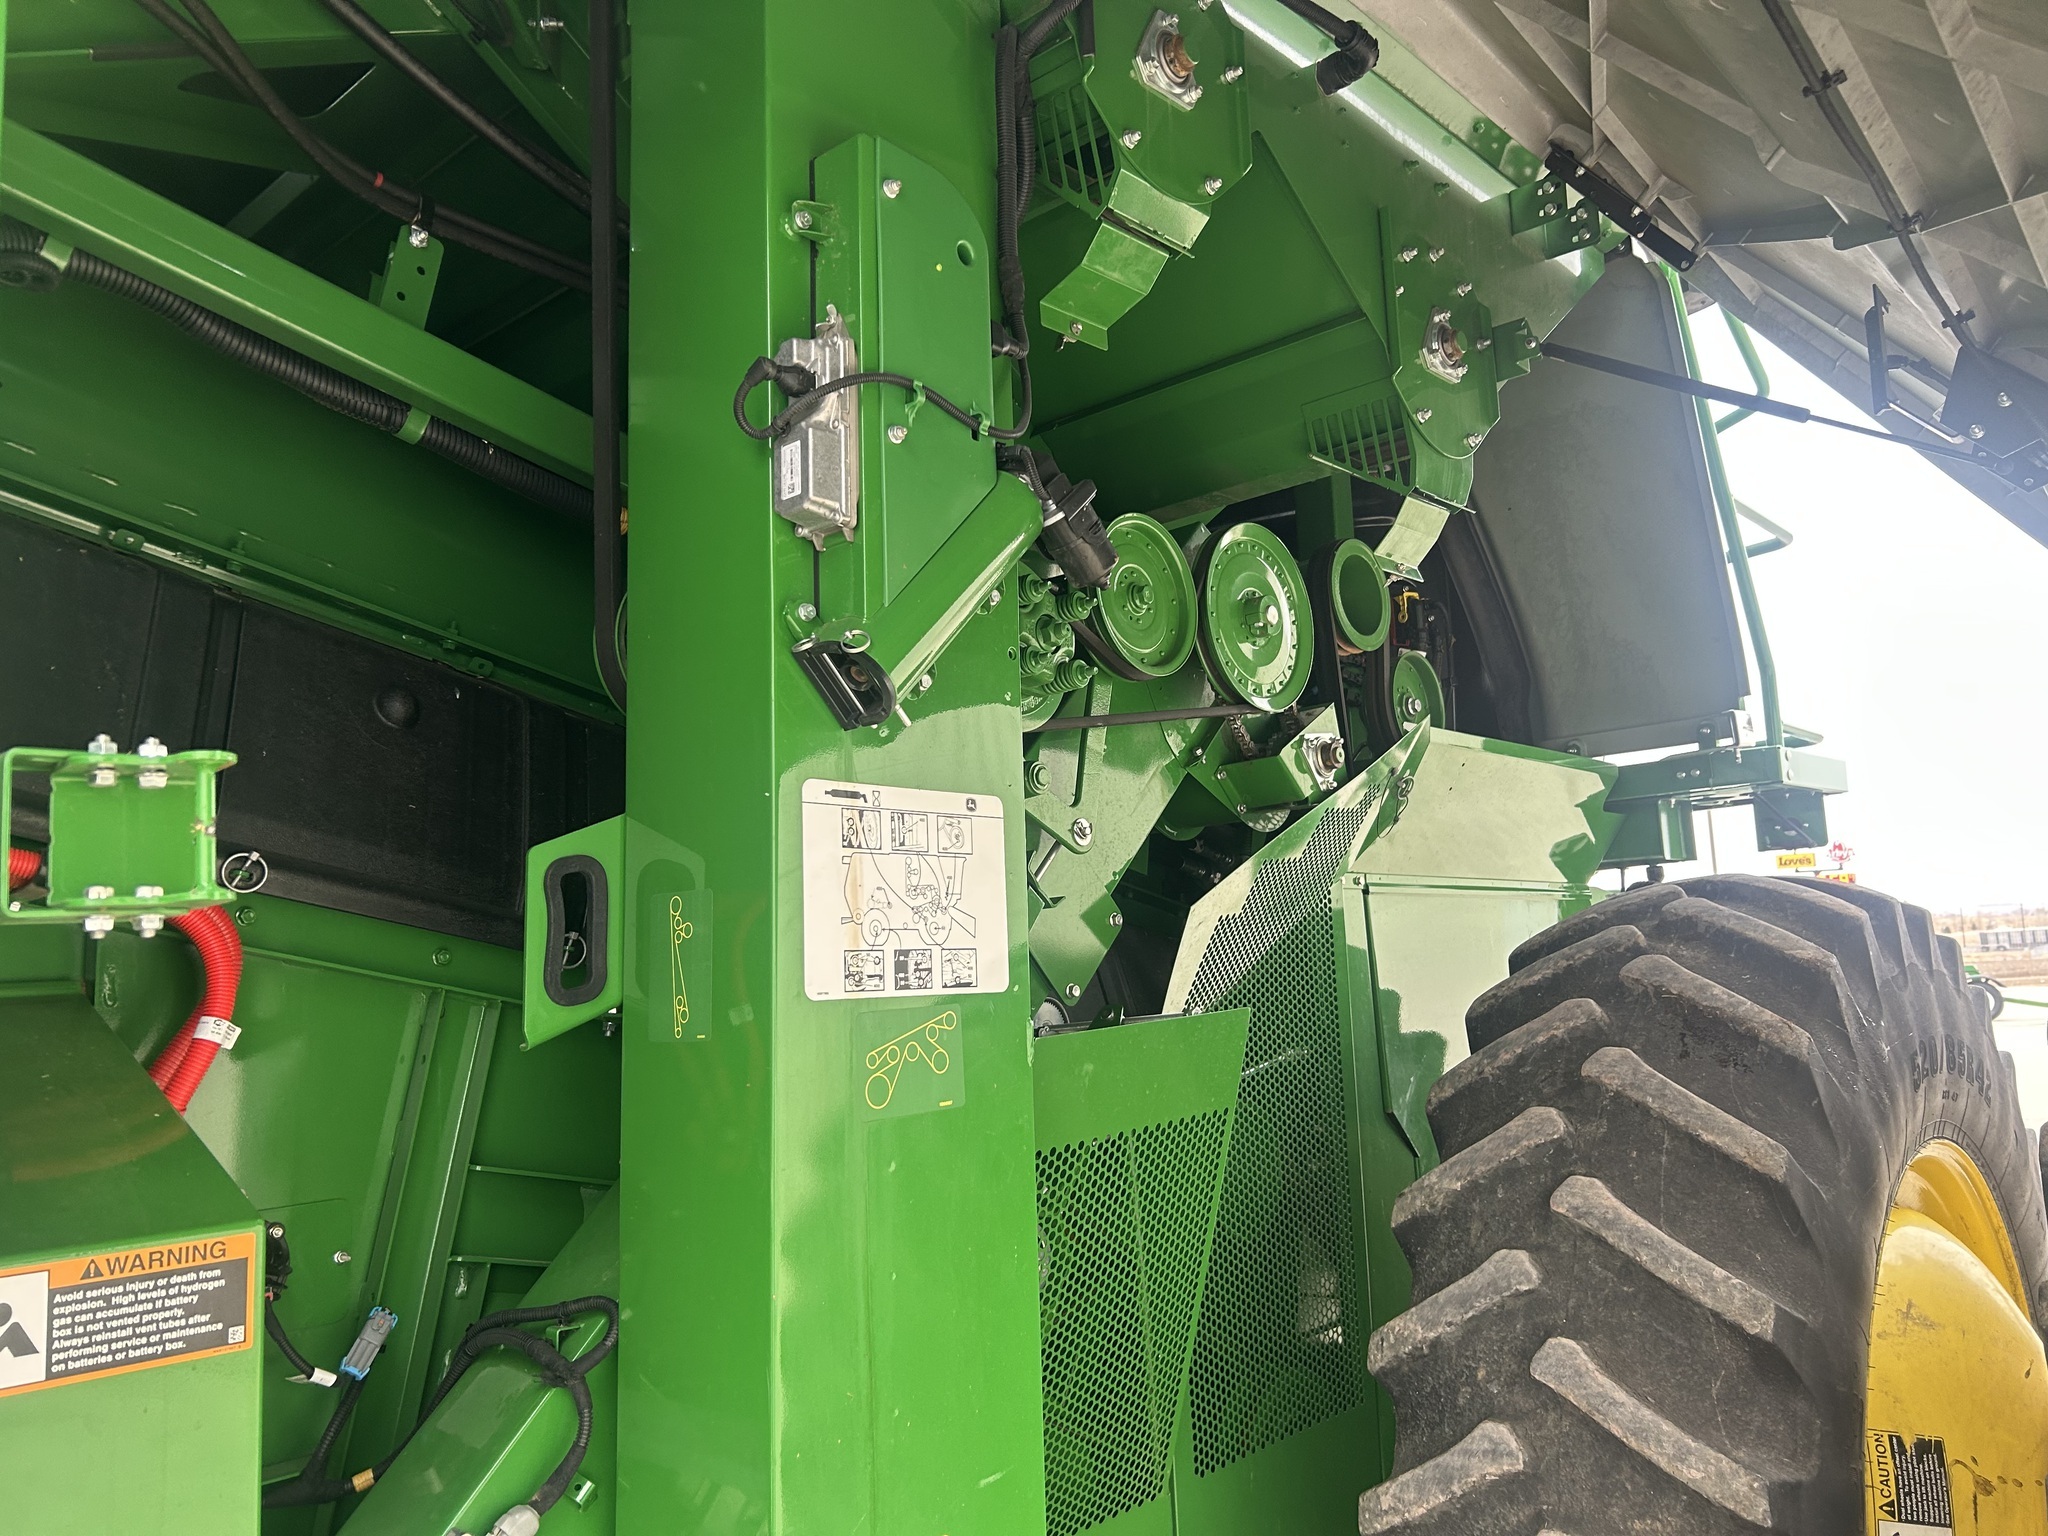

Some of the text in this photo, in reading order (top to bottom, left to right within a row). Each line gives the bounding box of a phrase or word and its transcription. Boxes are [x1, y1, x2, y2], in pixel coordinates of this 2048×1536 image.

[1778, 855, 1812, 866] Love's
[105, 1241, 227, 1275] WARNING
[52, 1278, 226, 1316] explosion. High levels of hydrogen
[53, 1268, 222, 1304] Avoid serious injury or death from
[52, 1293, 199, 1329] gas can accumulate if battery
[52, 1306, 185, 1339] box is not vented properly.
[51, 1313, 212, 1351] Always reinstall vent tubes after
[51, 1322, 224, 1363] performing service or maintenance
[51, 1341, 187, 1373] on batteries or battery box.
